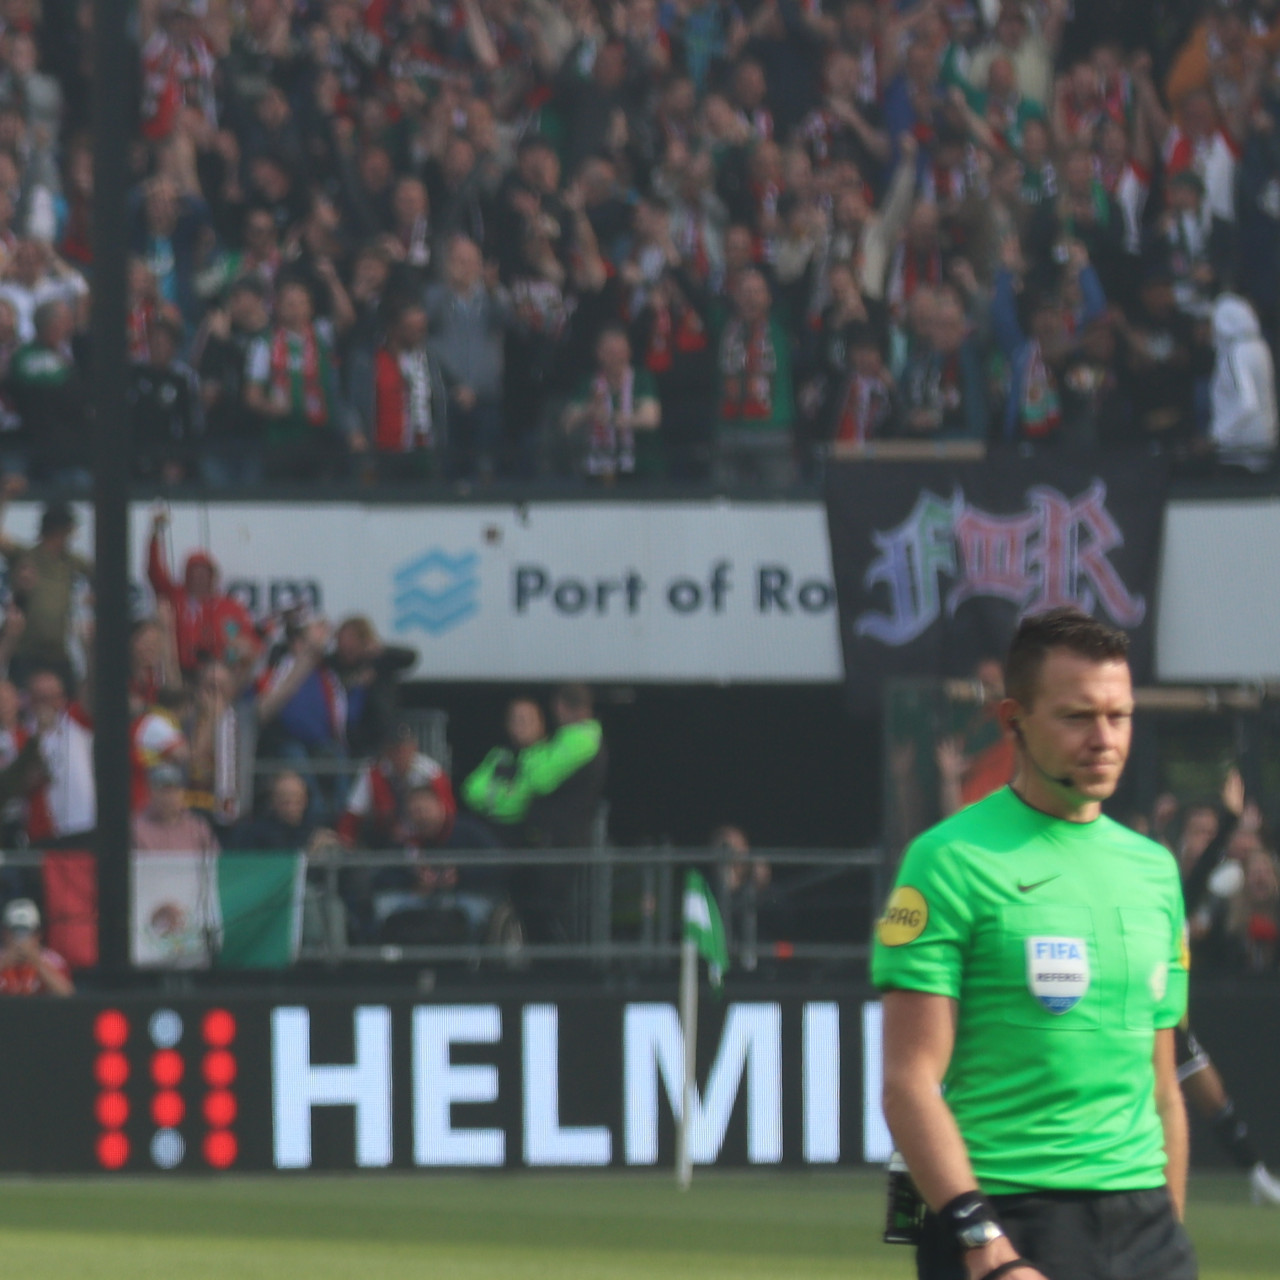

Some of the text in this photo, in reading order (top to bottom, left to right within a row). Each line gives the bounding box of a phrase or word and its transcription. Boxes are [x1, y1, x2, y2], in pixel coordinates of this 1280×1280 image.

[513, 558, 837, 617] Port of Ro
[1036, 942, 1082, 960] FIFA
